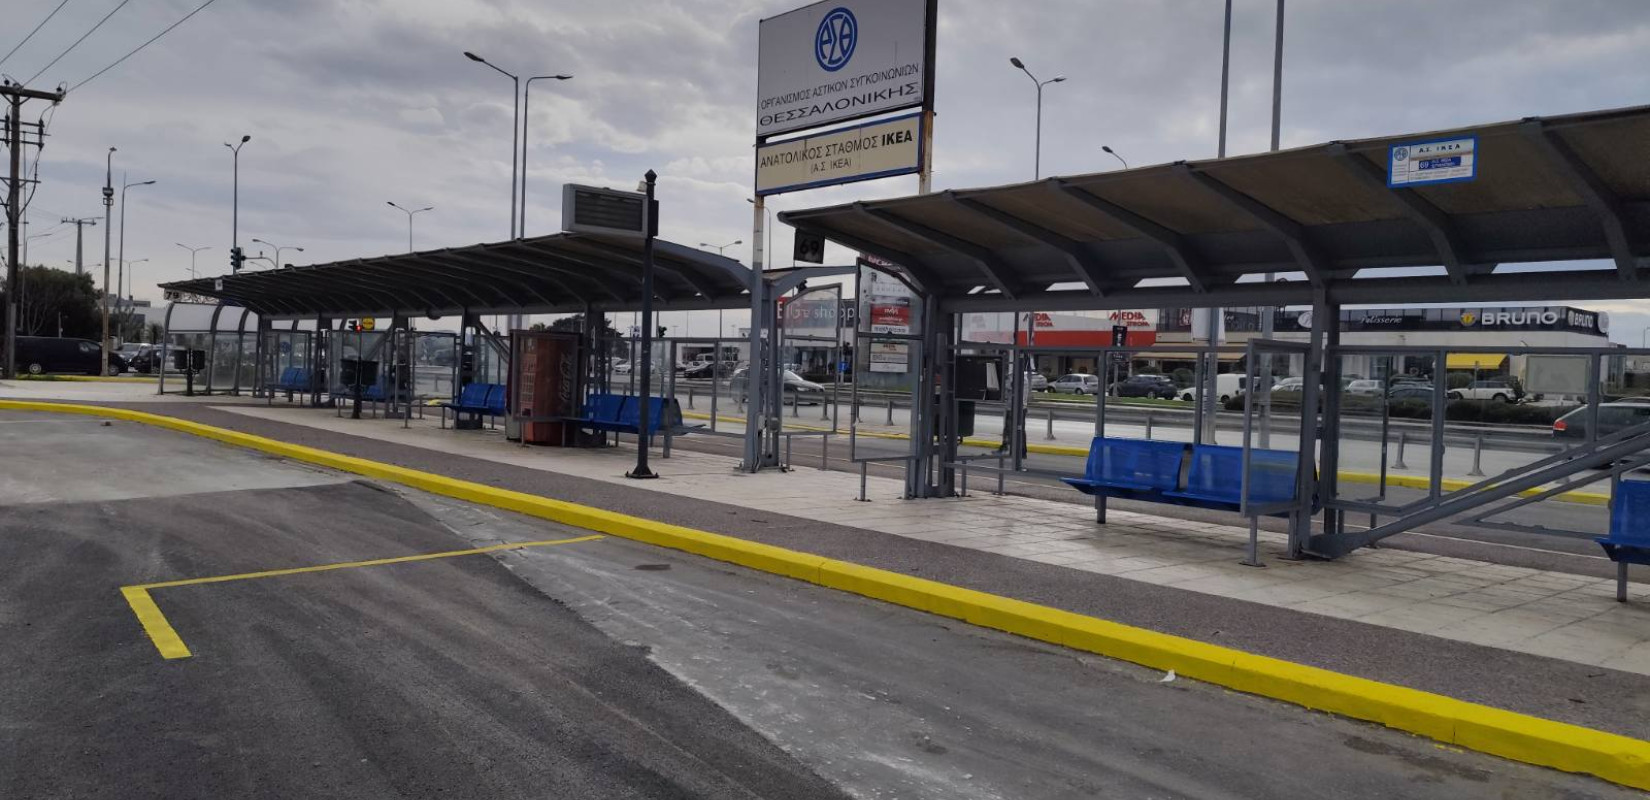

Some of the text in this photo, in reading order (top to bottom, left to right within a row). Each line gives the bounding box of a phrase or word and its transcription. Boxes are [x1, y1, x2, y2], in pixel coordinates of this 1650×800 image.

[760, 63, 919, 110] ΟΡΓΑΝΙΣΜΟΣ ΑΣΤΙΚΩΝ ΣΥΓΚΟΙΝΩΝΙΩΝ
[760, 81, 919, 127] ΘΕΣΣΑΛΟΝΙΚΗΣ
[760, 145, 822, 169] ΑΝΑΤΟΛΙΚΟΣ
[825, 135, 879, 157] ΣΤΑΘΜΟΣ
[1419, 161, 1429, 169] 69
[799, 238, 819, 256] 69
[1481, 311, 1559, 326] BRUNO
[1573, 312, 1594, 328] BRUNO
